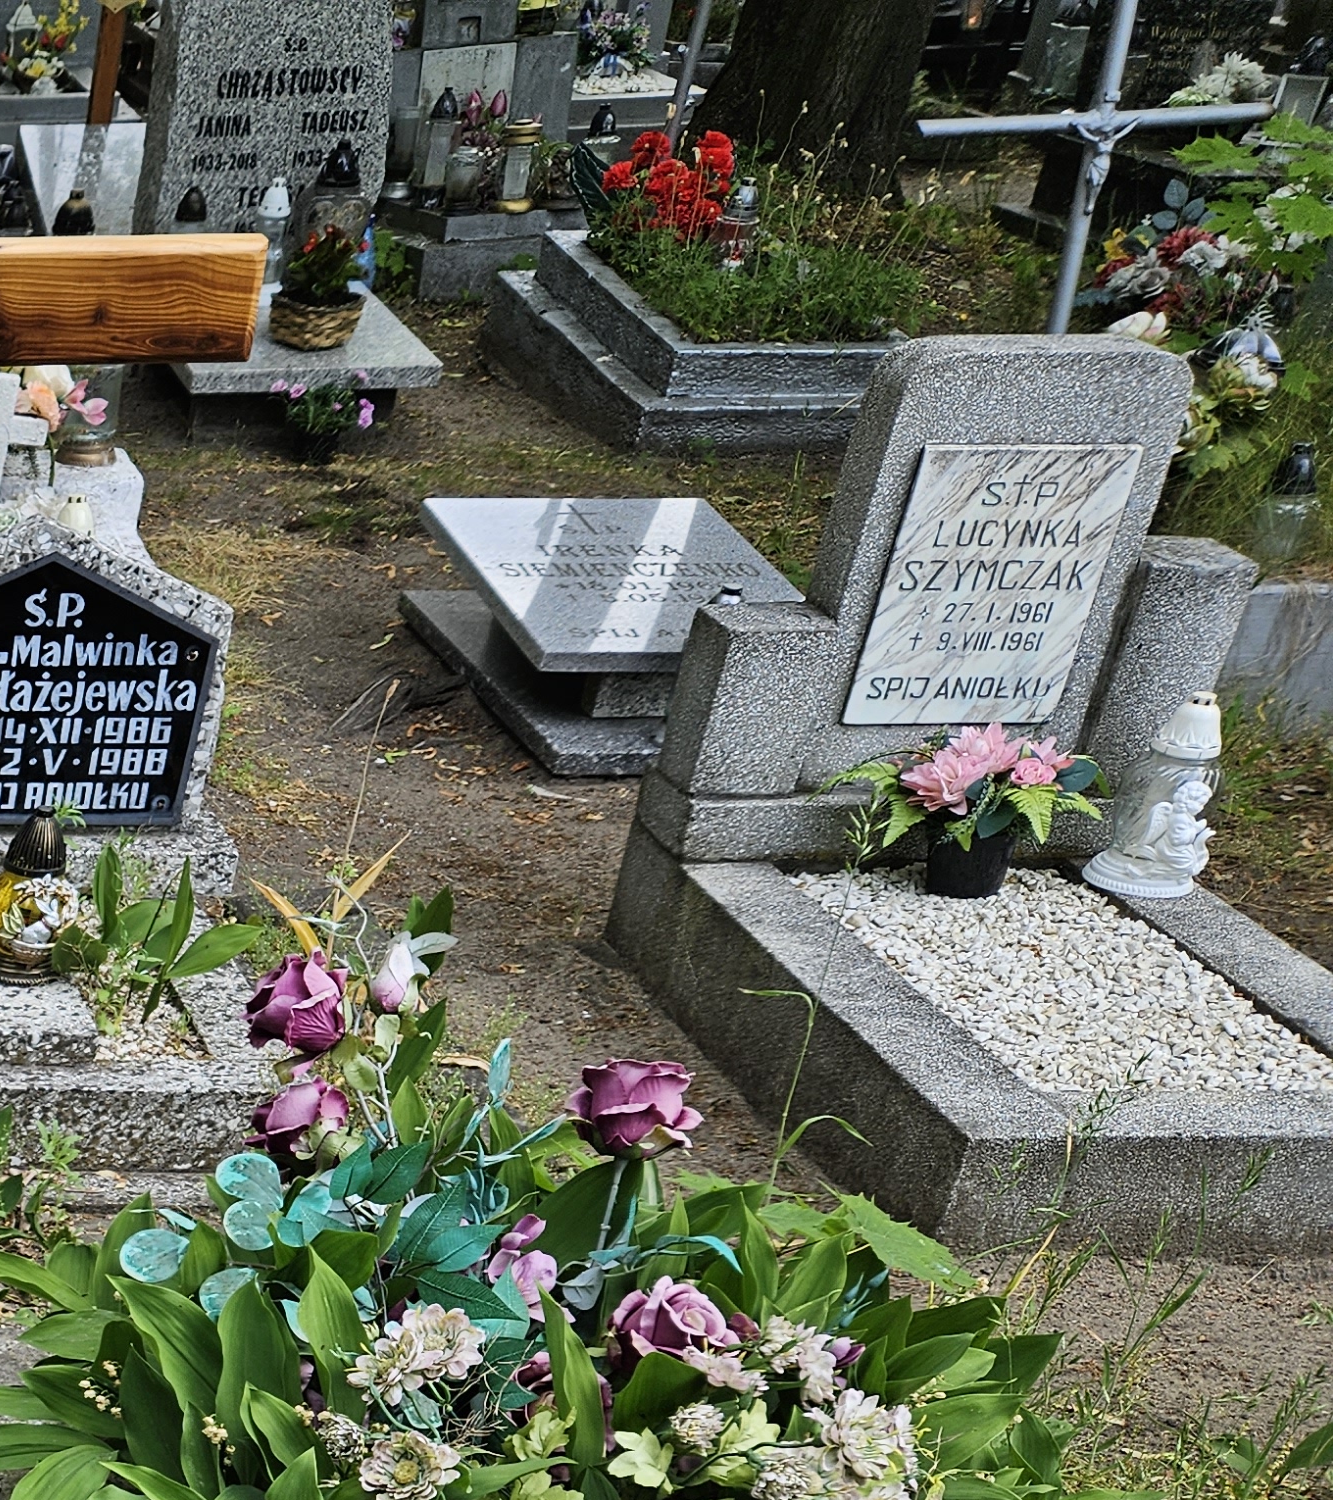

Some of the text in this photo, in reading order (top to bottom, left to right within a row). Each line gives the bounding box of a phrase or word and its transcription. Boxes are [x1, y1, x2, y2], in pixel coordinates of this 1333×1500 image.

[217, 66, 363, 101] CHRZĄSTOWSCY
[195, 110, 369, 138] JANINA TADEUSZ
[933, 519, 1082, 549] LUCYNKA
[537, 544, 684, 557] IRENKA
[899, 560, 1093, 592] SZYMCZAK
[24, 588, 86, 628] Ś.P.
[11, 632, 179, 667] Malwinka
[866, 676, 1051, 700] SPIJ ANIOŁKU
